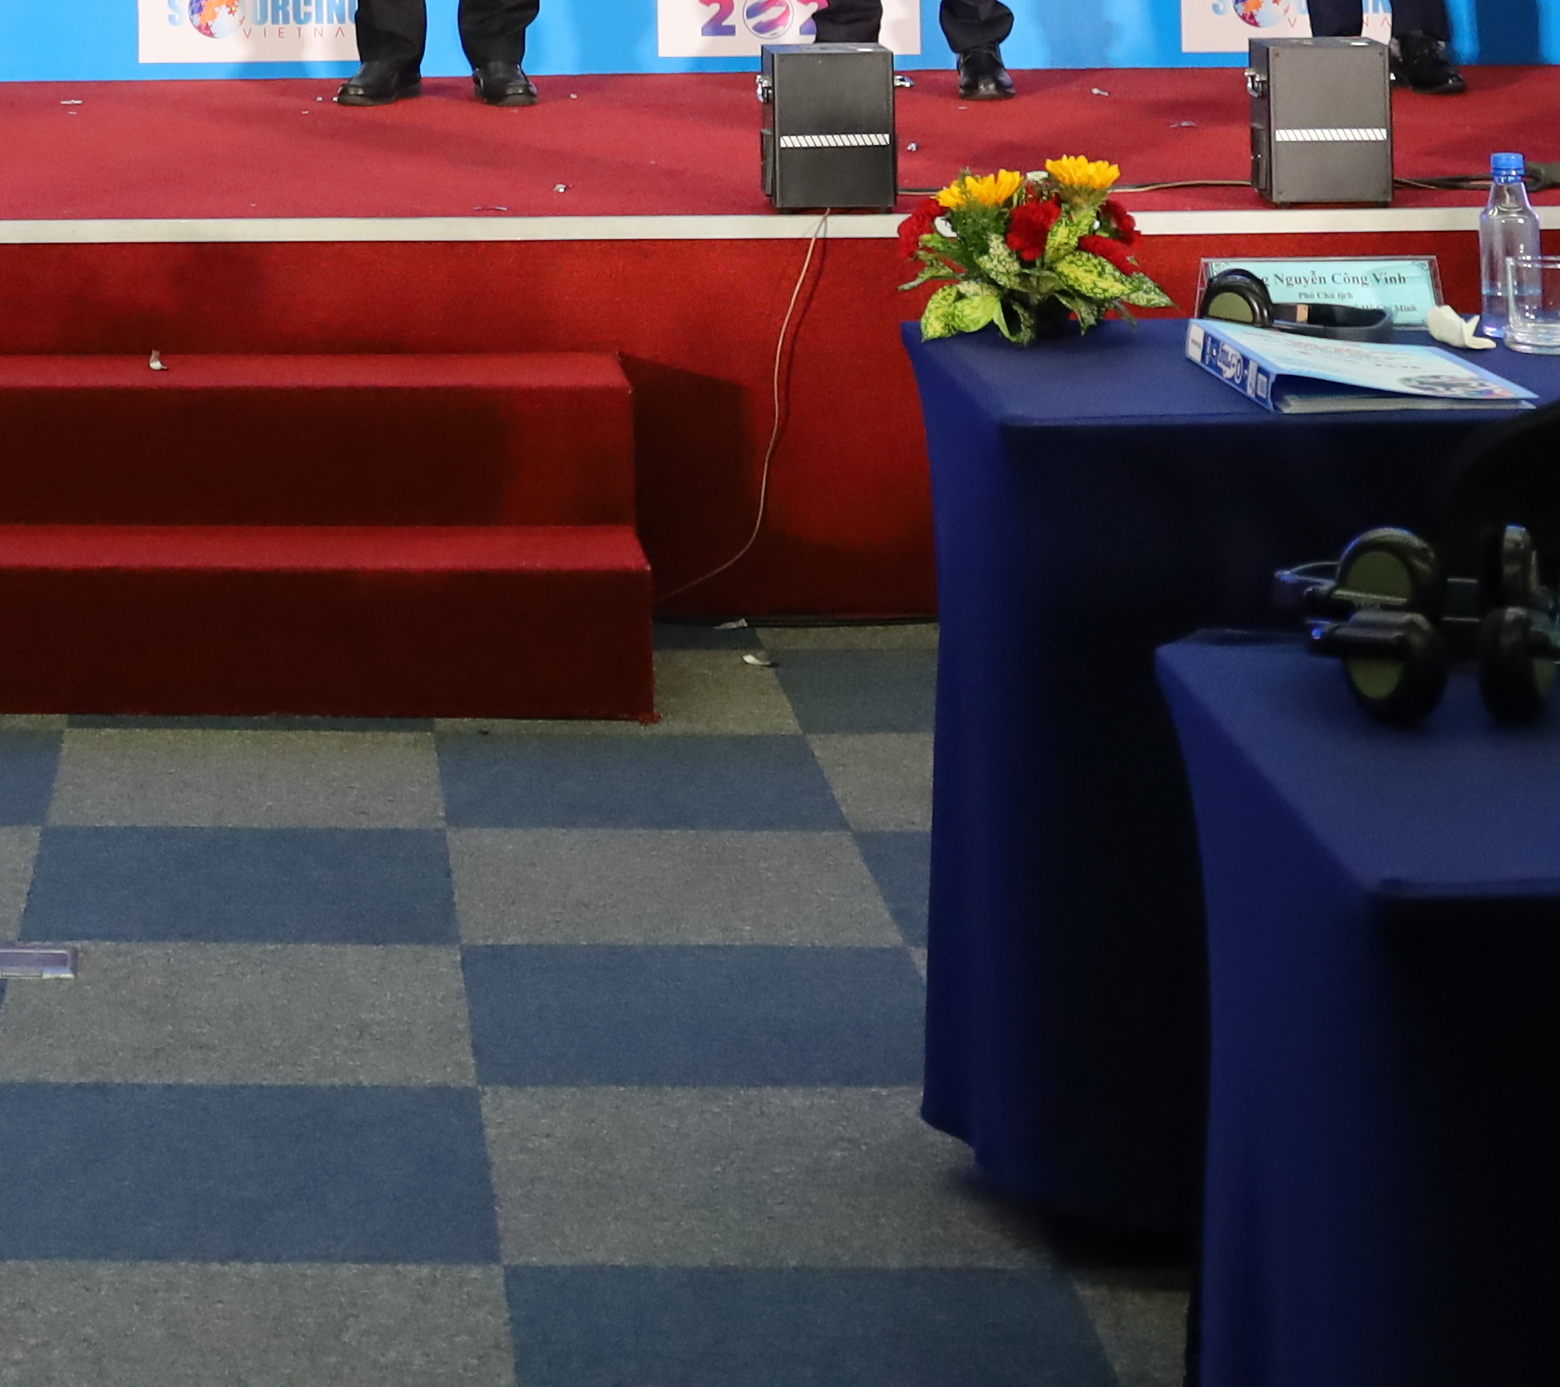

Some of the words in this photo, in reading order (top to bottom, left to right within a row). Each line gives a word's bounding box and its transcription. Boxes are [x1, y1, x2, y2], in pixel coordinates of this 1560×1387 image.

[241, 27, 346, 40] VIETNA
[1273, 269, 1327, 288] Nguyễn
[1331, 270, 1369, 287] Công
